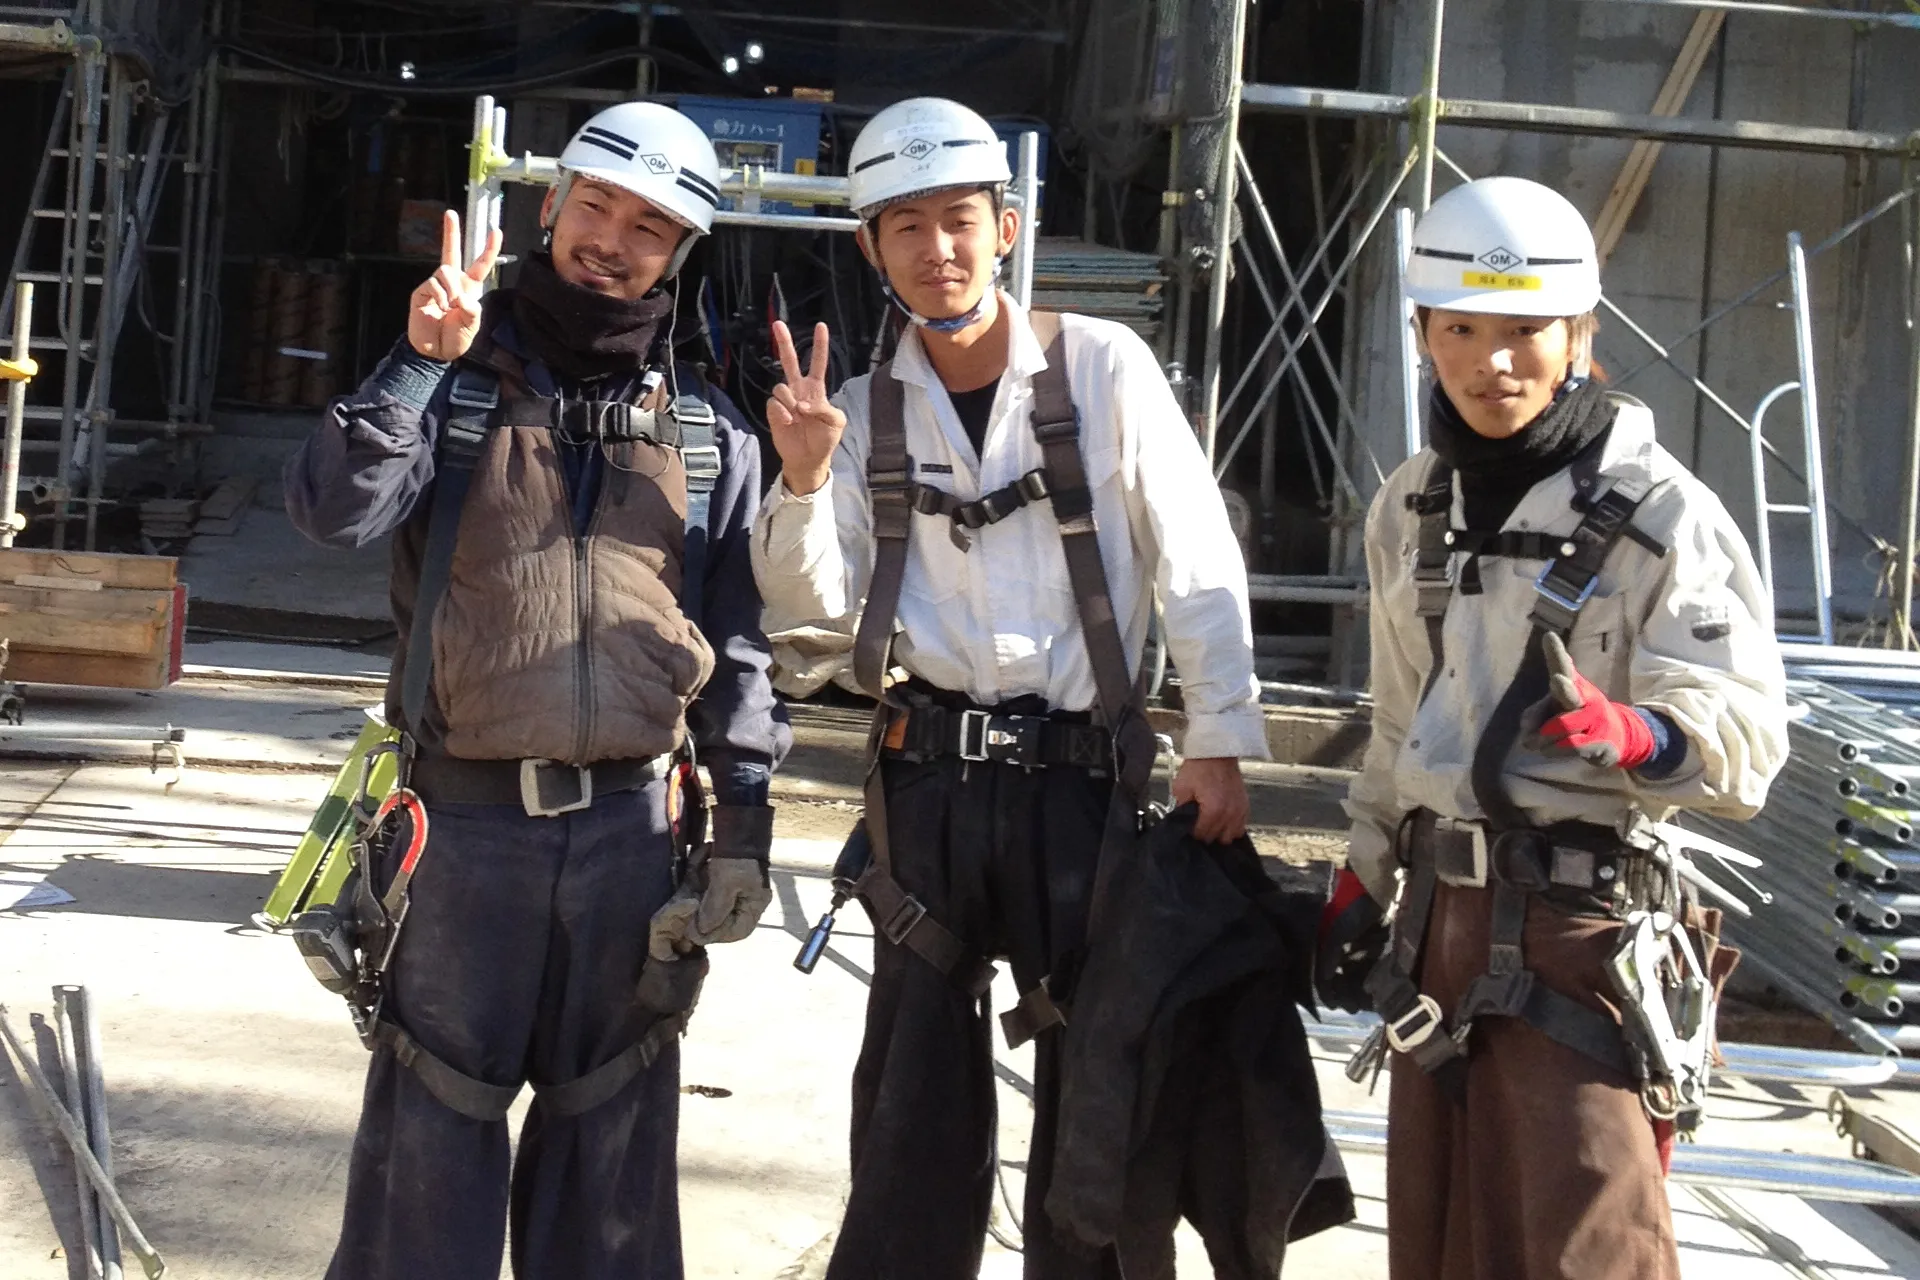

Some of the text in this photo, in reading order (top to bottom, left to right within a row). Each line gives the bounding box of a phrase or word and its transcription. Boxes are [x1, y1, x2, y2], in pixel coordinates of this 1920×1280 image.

[910, 143, 927, 155] OM
[650, 157, 667, 171] OM
[1490, 254, 1511, 265] OM
